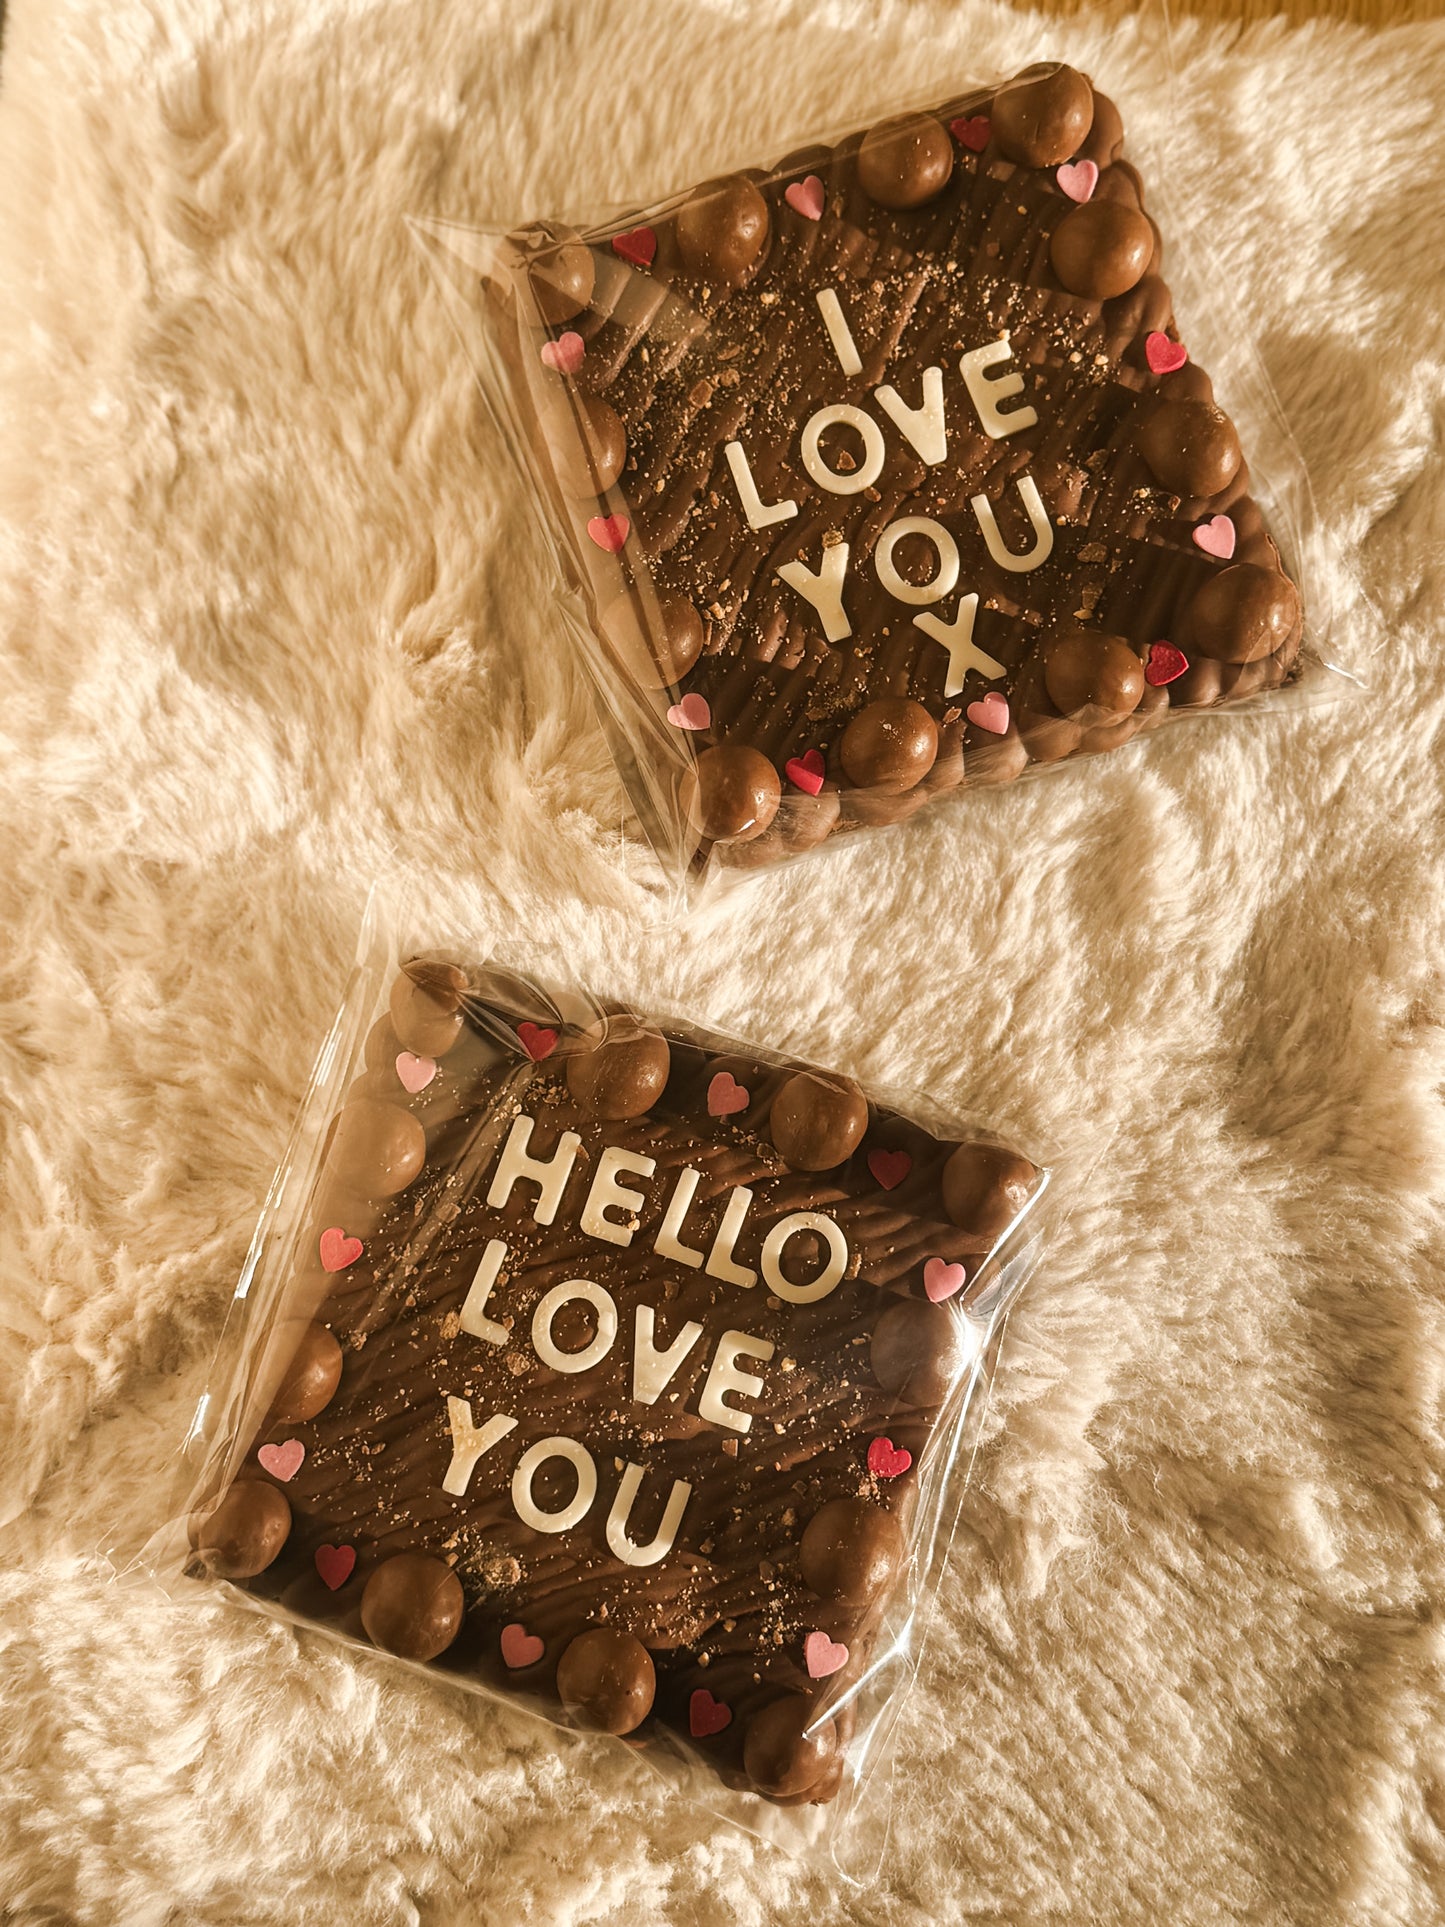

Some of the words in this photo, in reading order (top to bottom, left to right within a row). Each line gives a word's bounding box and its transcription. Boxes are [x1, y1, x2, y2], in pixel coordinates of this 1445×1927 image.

[816, 289, 863, 376] I
[724, 338, 1038, 529] LOVE
[777, 475, 1053, 642] YOU
[912, 593, 1005, 697] X
[486, 1114, 848, 1304] HELLO
[460, 1239, 775, 1433] LOVE
[442, 1396, 691, 1566] YOU
